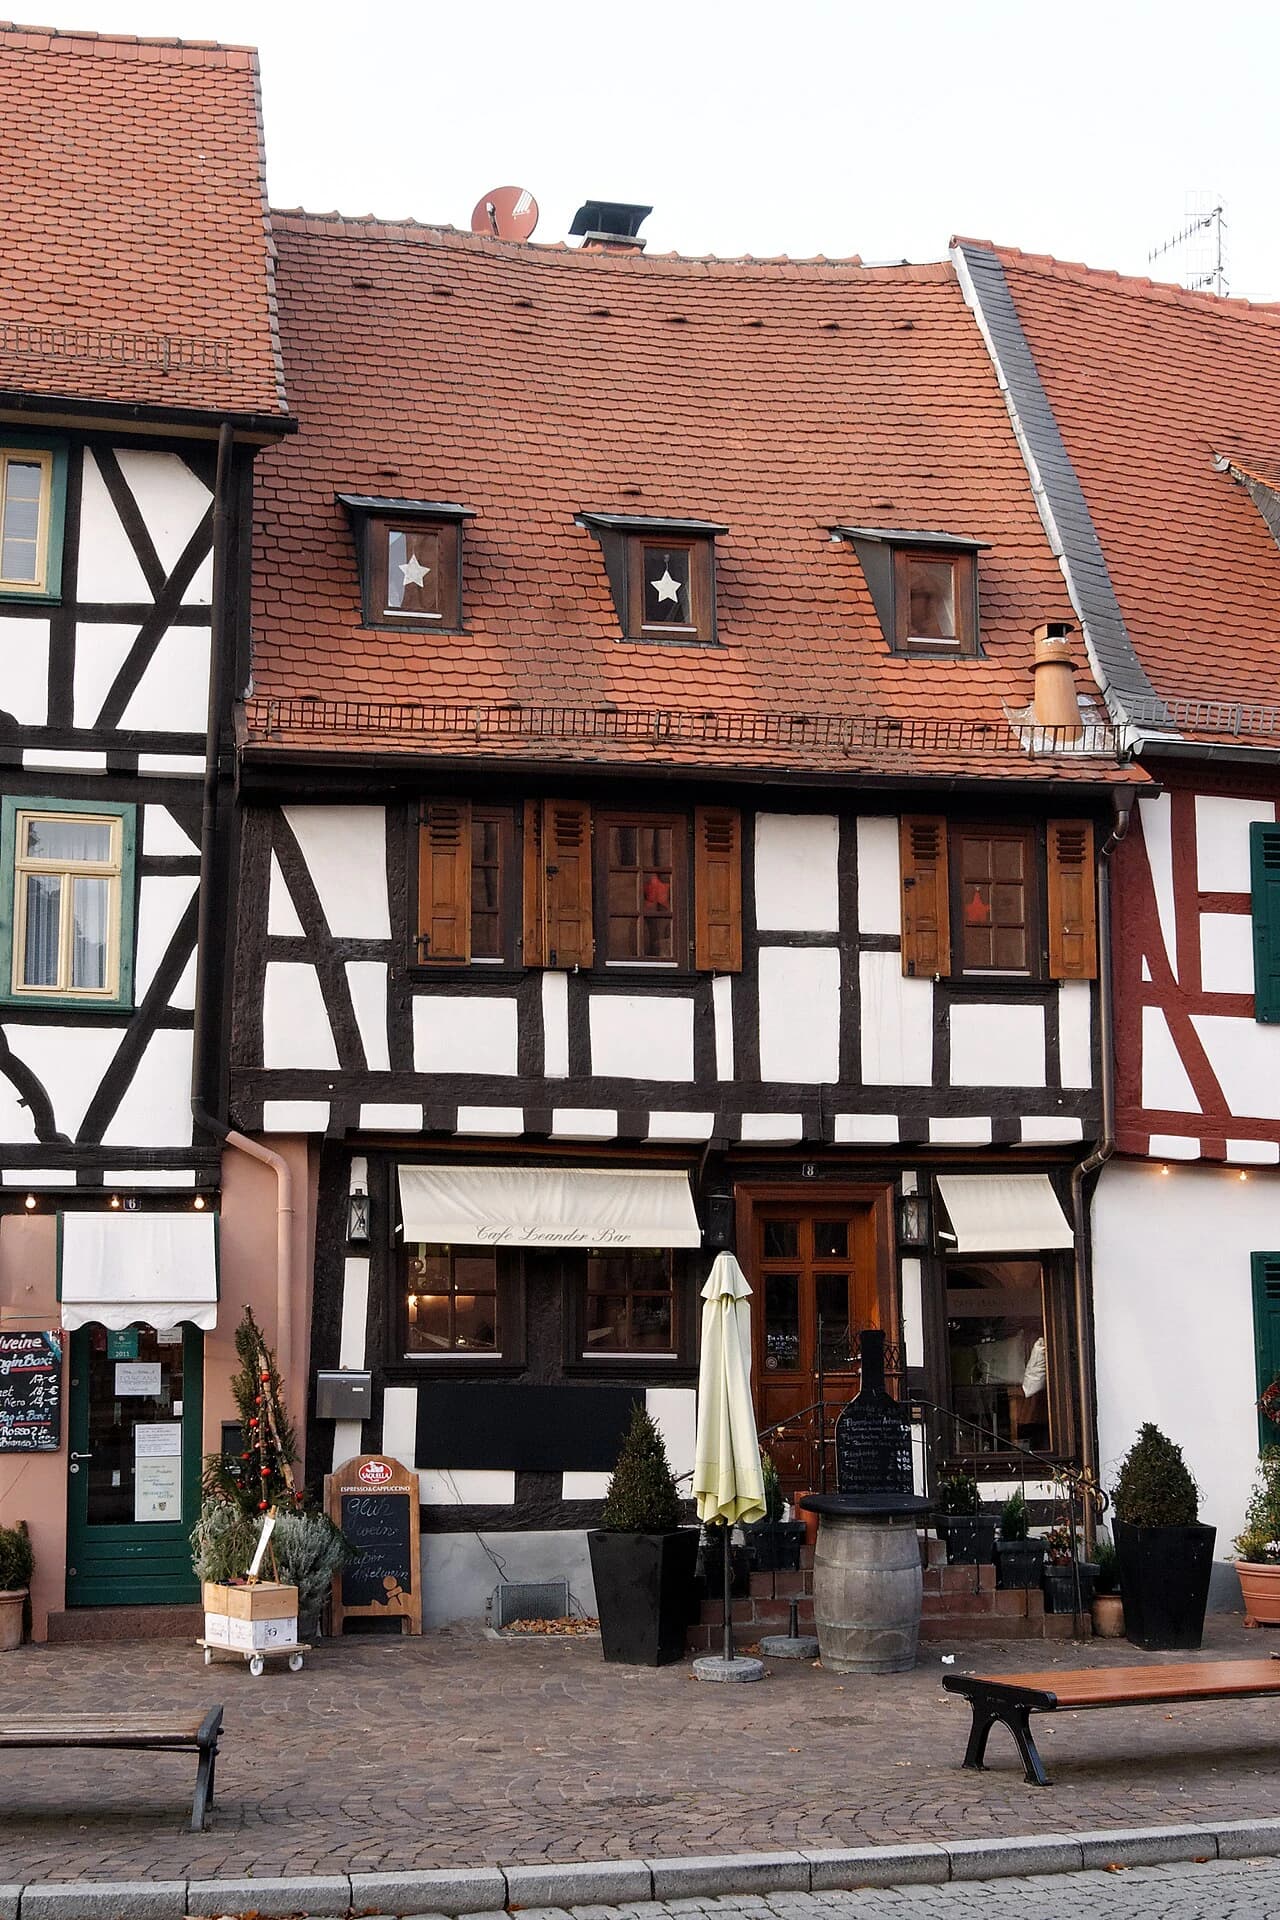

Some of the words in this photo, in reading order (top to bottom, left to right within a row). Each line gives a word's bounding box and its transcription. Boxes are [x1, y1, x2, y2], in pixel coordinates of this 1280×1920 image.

[806, 1165, 814, 1176] 8
[129, 1198, 136, 1209] 6
[476, 1224, 513, 1245] Cafe
[519, 1225, 588, 1242] Leander
[592, 1227, 632, 1243] Bar
[4, 1397, 26, 1408] Nero
[2, 1426, 30, 1437] Rosso
